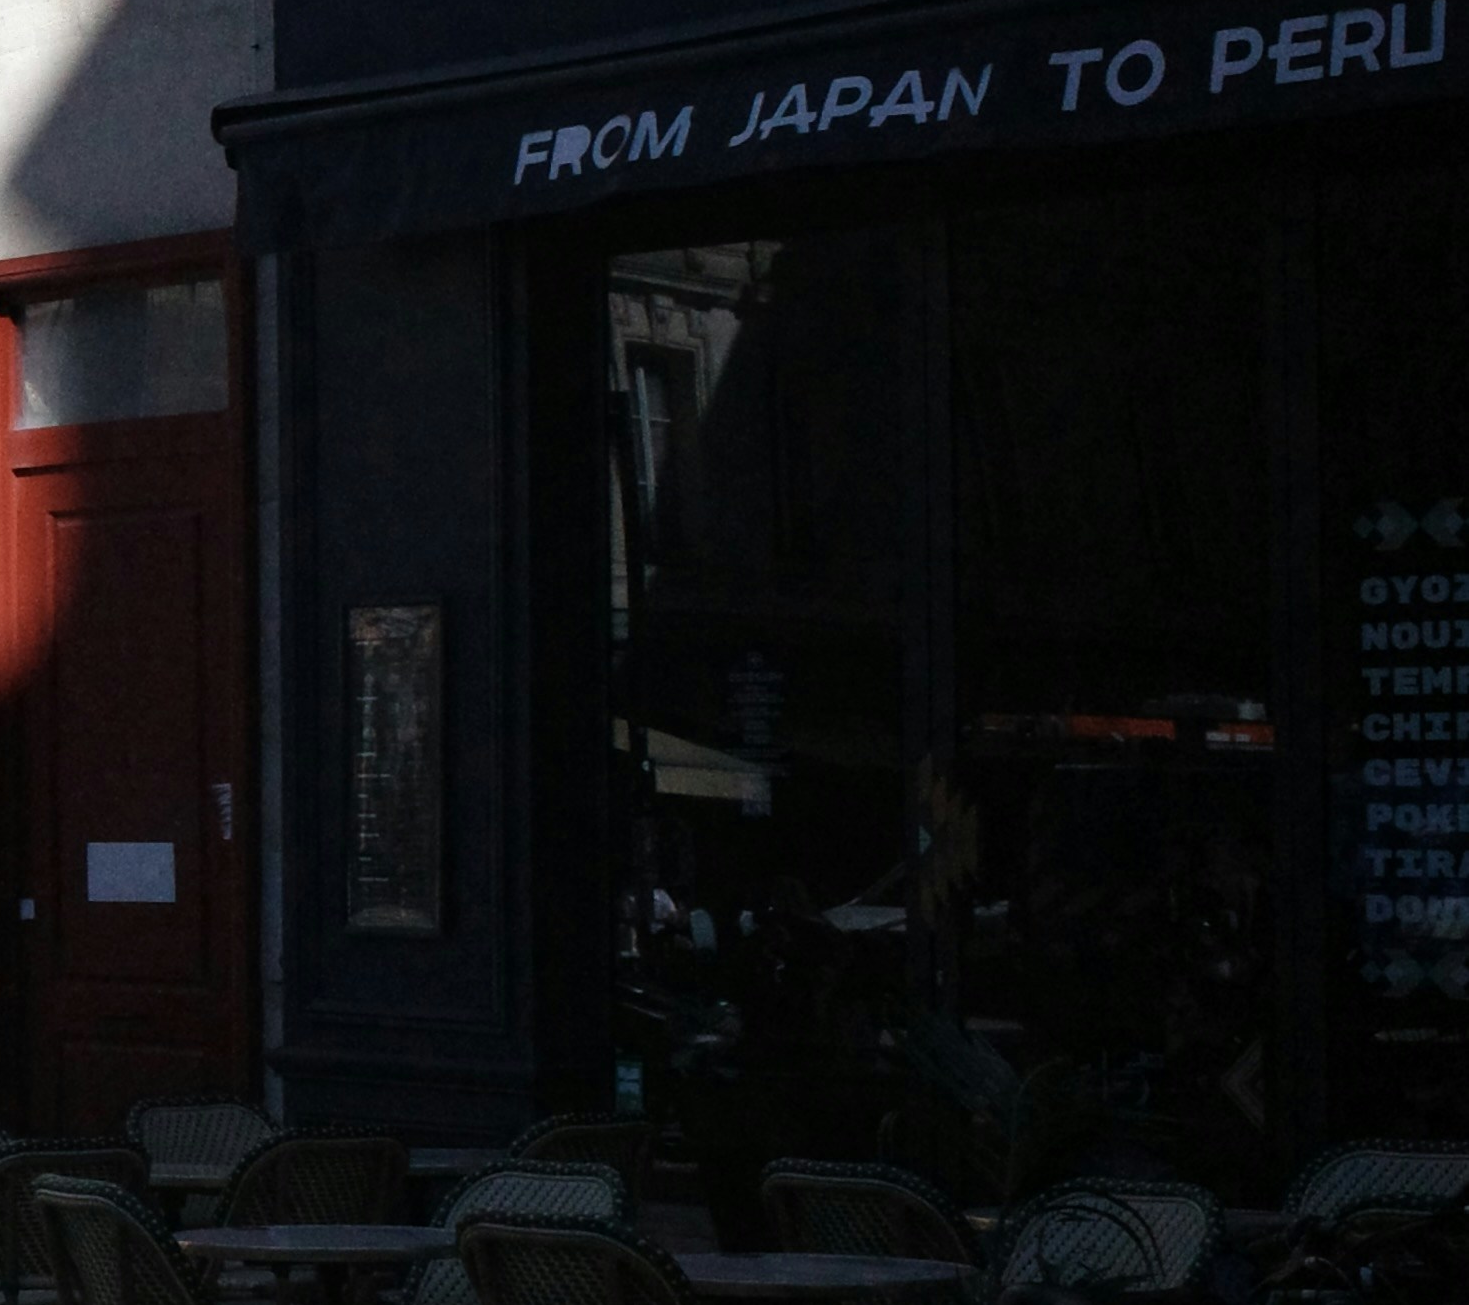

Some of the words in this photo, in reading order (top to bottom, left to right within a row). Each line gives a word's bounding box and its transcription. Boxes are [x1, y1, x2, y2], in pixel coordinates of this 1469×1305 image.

[514, 105, 694, 187] FROM
[728, 62, 994, 149] JAPAN
[1048, 38, 1165, 113] TO
